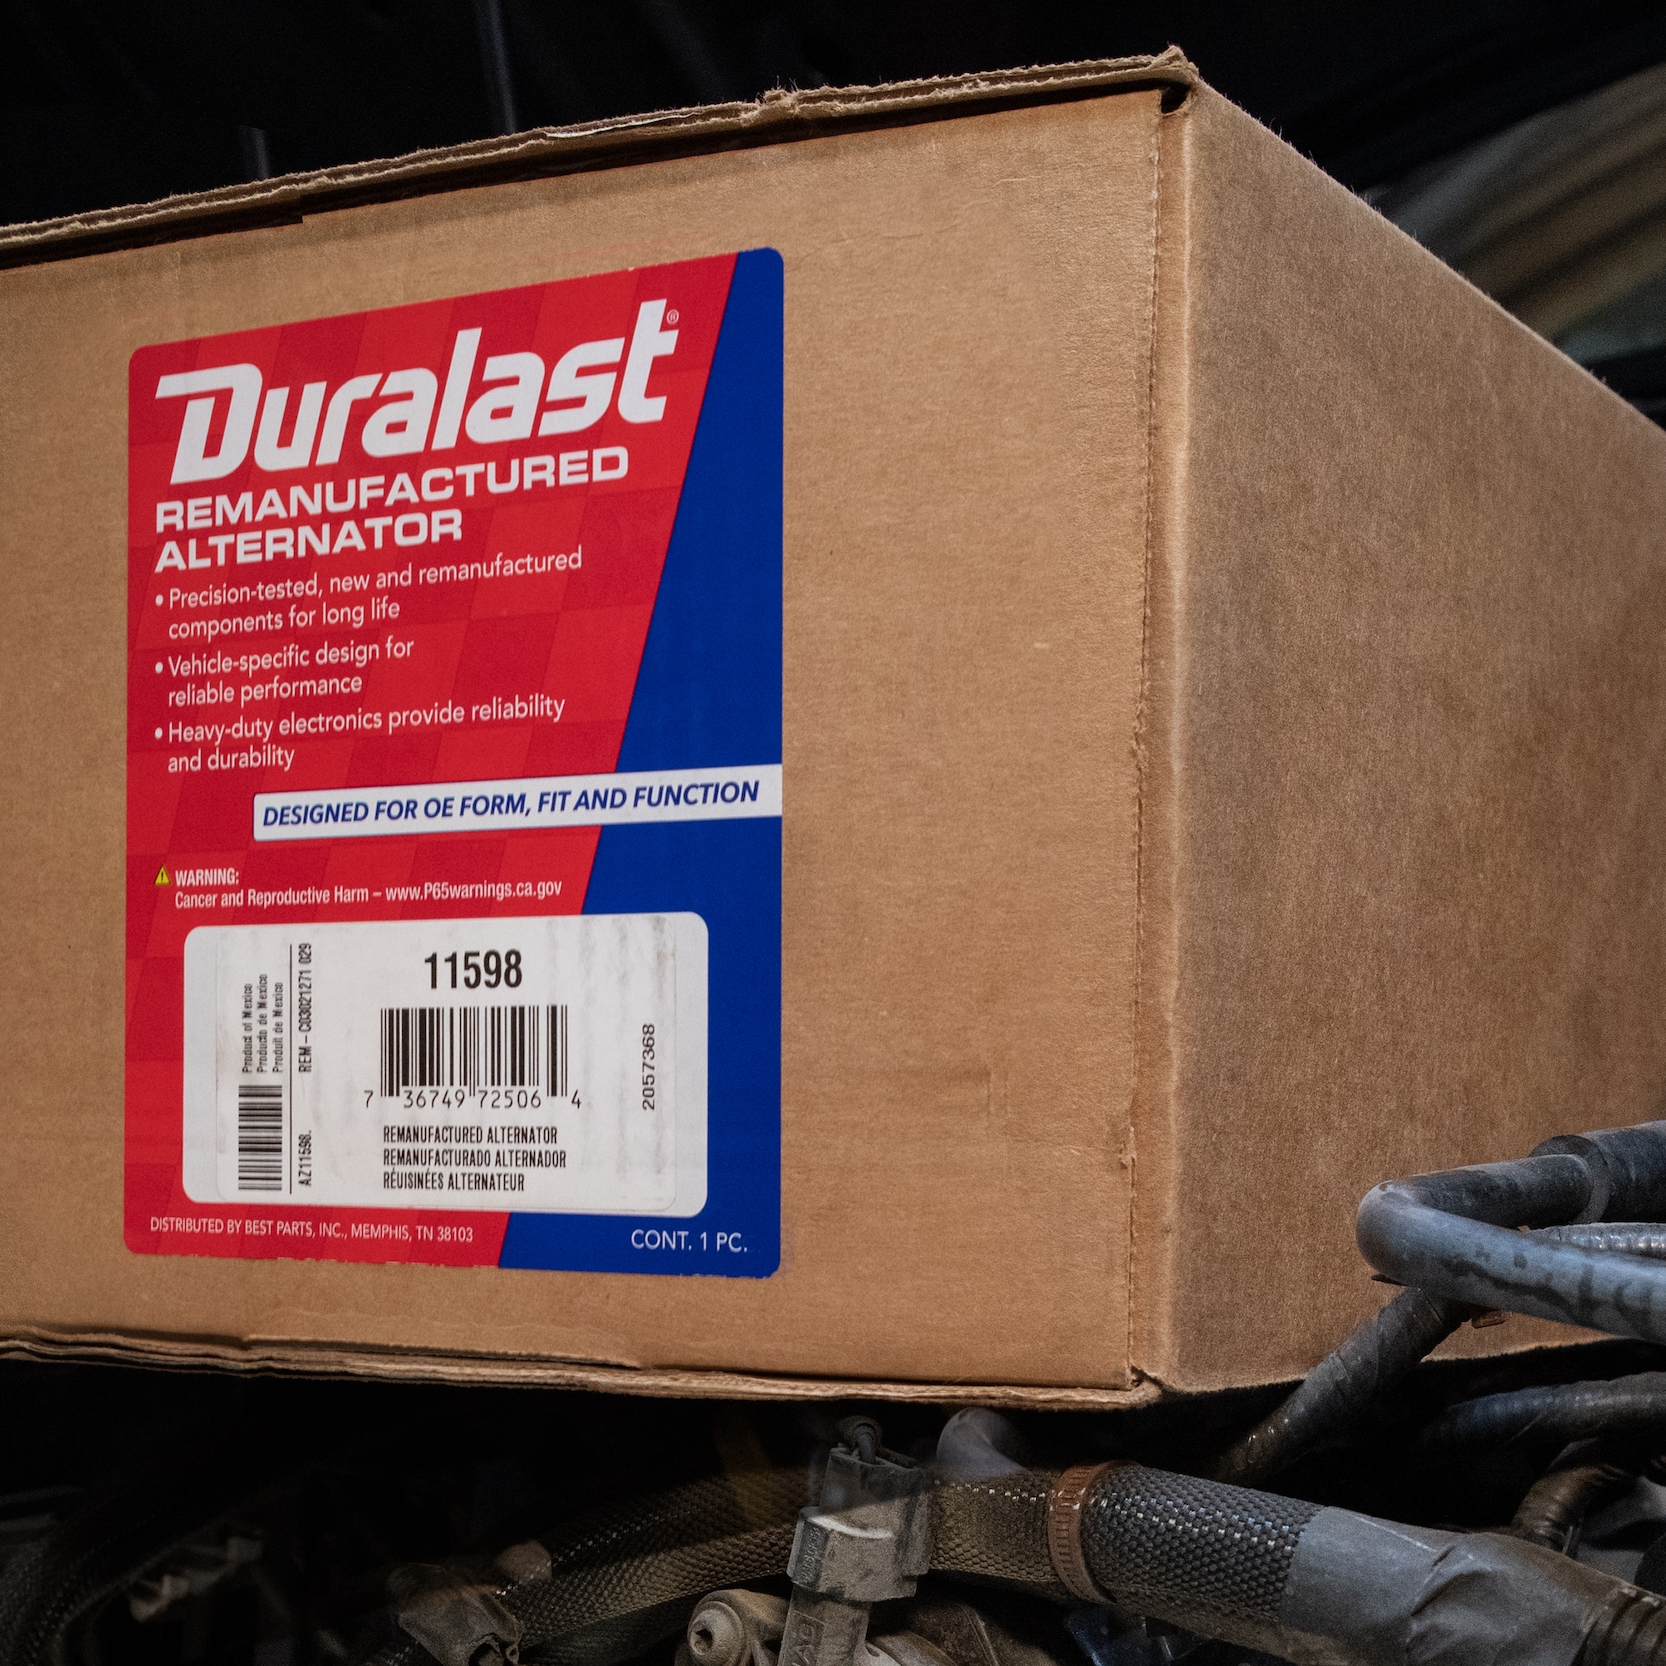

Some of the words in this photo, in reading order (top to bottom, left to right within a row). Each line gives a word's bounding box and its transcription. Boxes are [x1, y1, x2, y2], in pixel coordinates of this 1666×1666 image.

[154, 297, 680, 486] Duralast
[156, 443, 629, 535] REMANUFACTURED
[154, 506, 463, 574] ALTERNATOR
[169, 571, 323, 610] Precision-tested,
[329, 574, 370, 594] new
[375, 562, 412, 589] and
[418, 544, 582, 585] remanufactured
[168, 610, 284, 643] components
[288, 603, 317, 628] for
[322, 601, 365, 629] long
[371, 596, 401, 620] life
[167, 643, 310, 679] Vehicle-specific
[315, 639, 380, 668] design
[385, 634, 415, 659] for
[168, 679, 235, 707] reliable
[240, 674, 363, 709] performance
[168, 715, 274, 747] Heavy-duty
[278, 707, 383, 736] electronics
[388, 699, 465, 736] provide
[471, 692, 566, 723] reliability
[167, 748, 202, 773] and
[207, 743, 295, 772] durability
[263, 801, 369, 827] DESIGNED
[374, 799, 418, 821] FOR
[423, 796, 455, 819] OE
[459, 793, 531, 817] FORM,
[537, 790, 572, 813] FIT
[572, 787, 628, 811] AND
[633, 780, 760, 808] FUNCTION
[174, 891, 218, 909] Cancer
[220, 889, 244, 908] and
[247, 886, 331, 909] Reproductive
[334, 885, 369, 903] Harm
[385, 879, 563, 902] www.P65warnings.ca.gov
[175, 867, 240, 887] WARNING:
[298, 943, 312, 965] 029
[424, 948, 523, 990] 11598
[242, 983, 253, 1019] Mexico
[257, 974, 268, 1010] Mexico
[273, 982, 284, 1018] Mexico
[242, 1022, 253, 1032] of
[257, 1013, 268, 1026] de
[273, 1021, 284, 1034] de
[242, 1035, 253, 1074] Product
[257, 1029, 268, 1073] Producto
[272, 1037, 284, 1073] Produit
[641, 1023, 655, 1111] 2057368
[363, 1089, 374, 1109] 7
[403, 1089, 466, 1109] 36749
[477, 1089, 542, 1109] 72506
[571, 1089, 582, 1110] 4
[383, 1125, 483, 1144] REMANUFACTURED
[486, 1126, 558, 1145] ALTERNATOR
[383, 1148, 491, 1167] REMANUFACTURADO
[494, 1149, 567, 1168] ALTERNADOR
[383, 1167, 444, 1190] RÉUISINÉES
[447, 1172, 525, 1192] ALTERNATEUR
[150, 1216, 225, 1234] DISTRIBUTED
[226, 1218, 243, 1234] BY
[244, 1219, 274, 1236] BEST
[276, 1220, 316, 1239] PARTS,
[318, 1221, 348, 1240] INC.,
[350, 1223, 412, 1242] MEMPHIS,
[415, 1225, 434, 1241] TN
[437, 1225, 474, 1243] 38103
[631, 1228, 692, 1251] CONT.
[700, 1231, 707, 1251] 1
[716, 1231, 748, 1253] PC.
